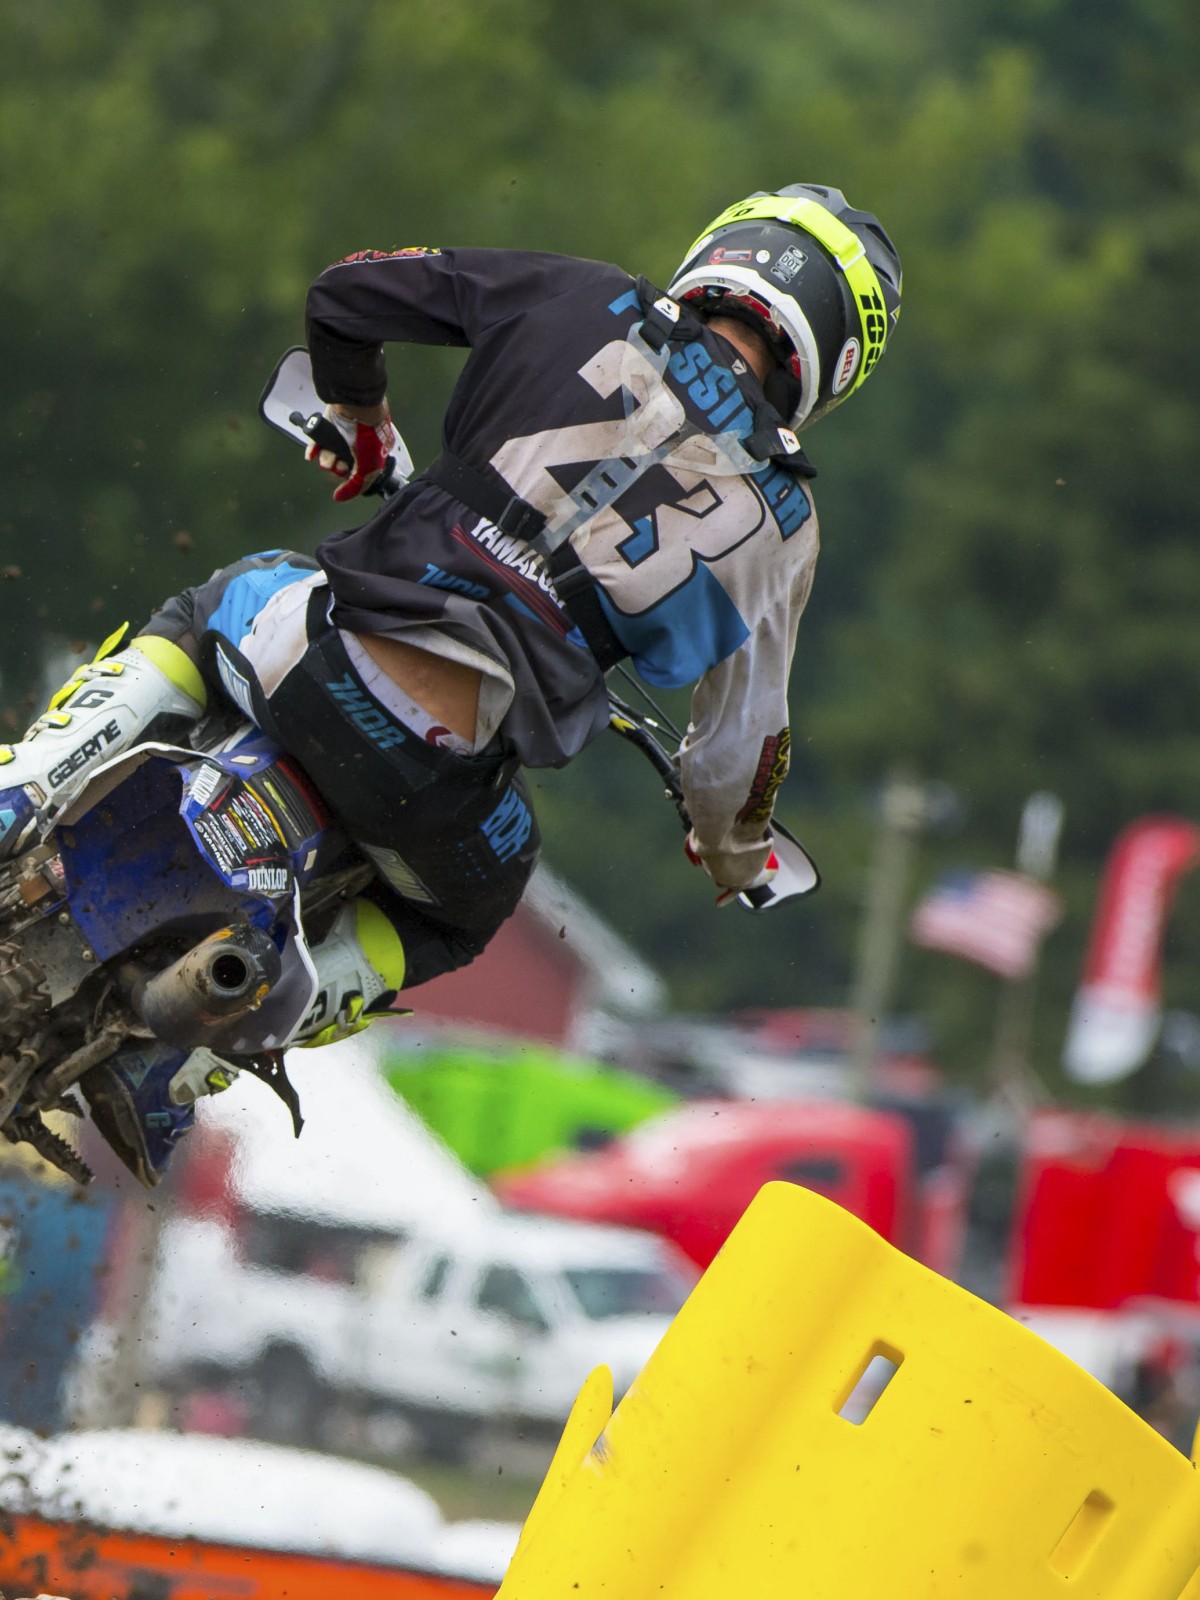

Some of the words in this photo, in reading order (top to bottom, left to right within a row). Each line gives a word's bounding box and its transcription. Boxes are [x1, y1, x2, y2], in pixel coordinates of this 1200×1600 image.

[781, 255, 800, 271] DOT
[838, 347, 855, 386] BELL
[490, 339, 766, 618] 23
[471, 516, 566, 610] YAMALU
[326, 672, 407, 750] THOR
[47, 718, 122, 788] GAERNE
[248, 867, 288, 891] DUNLOP
